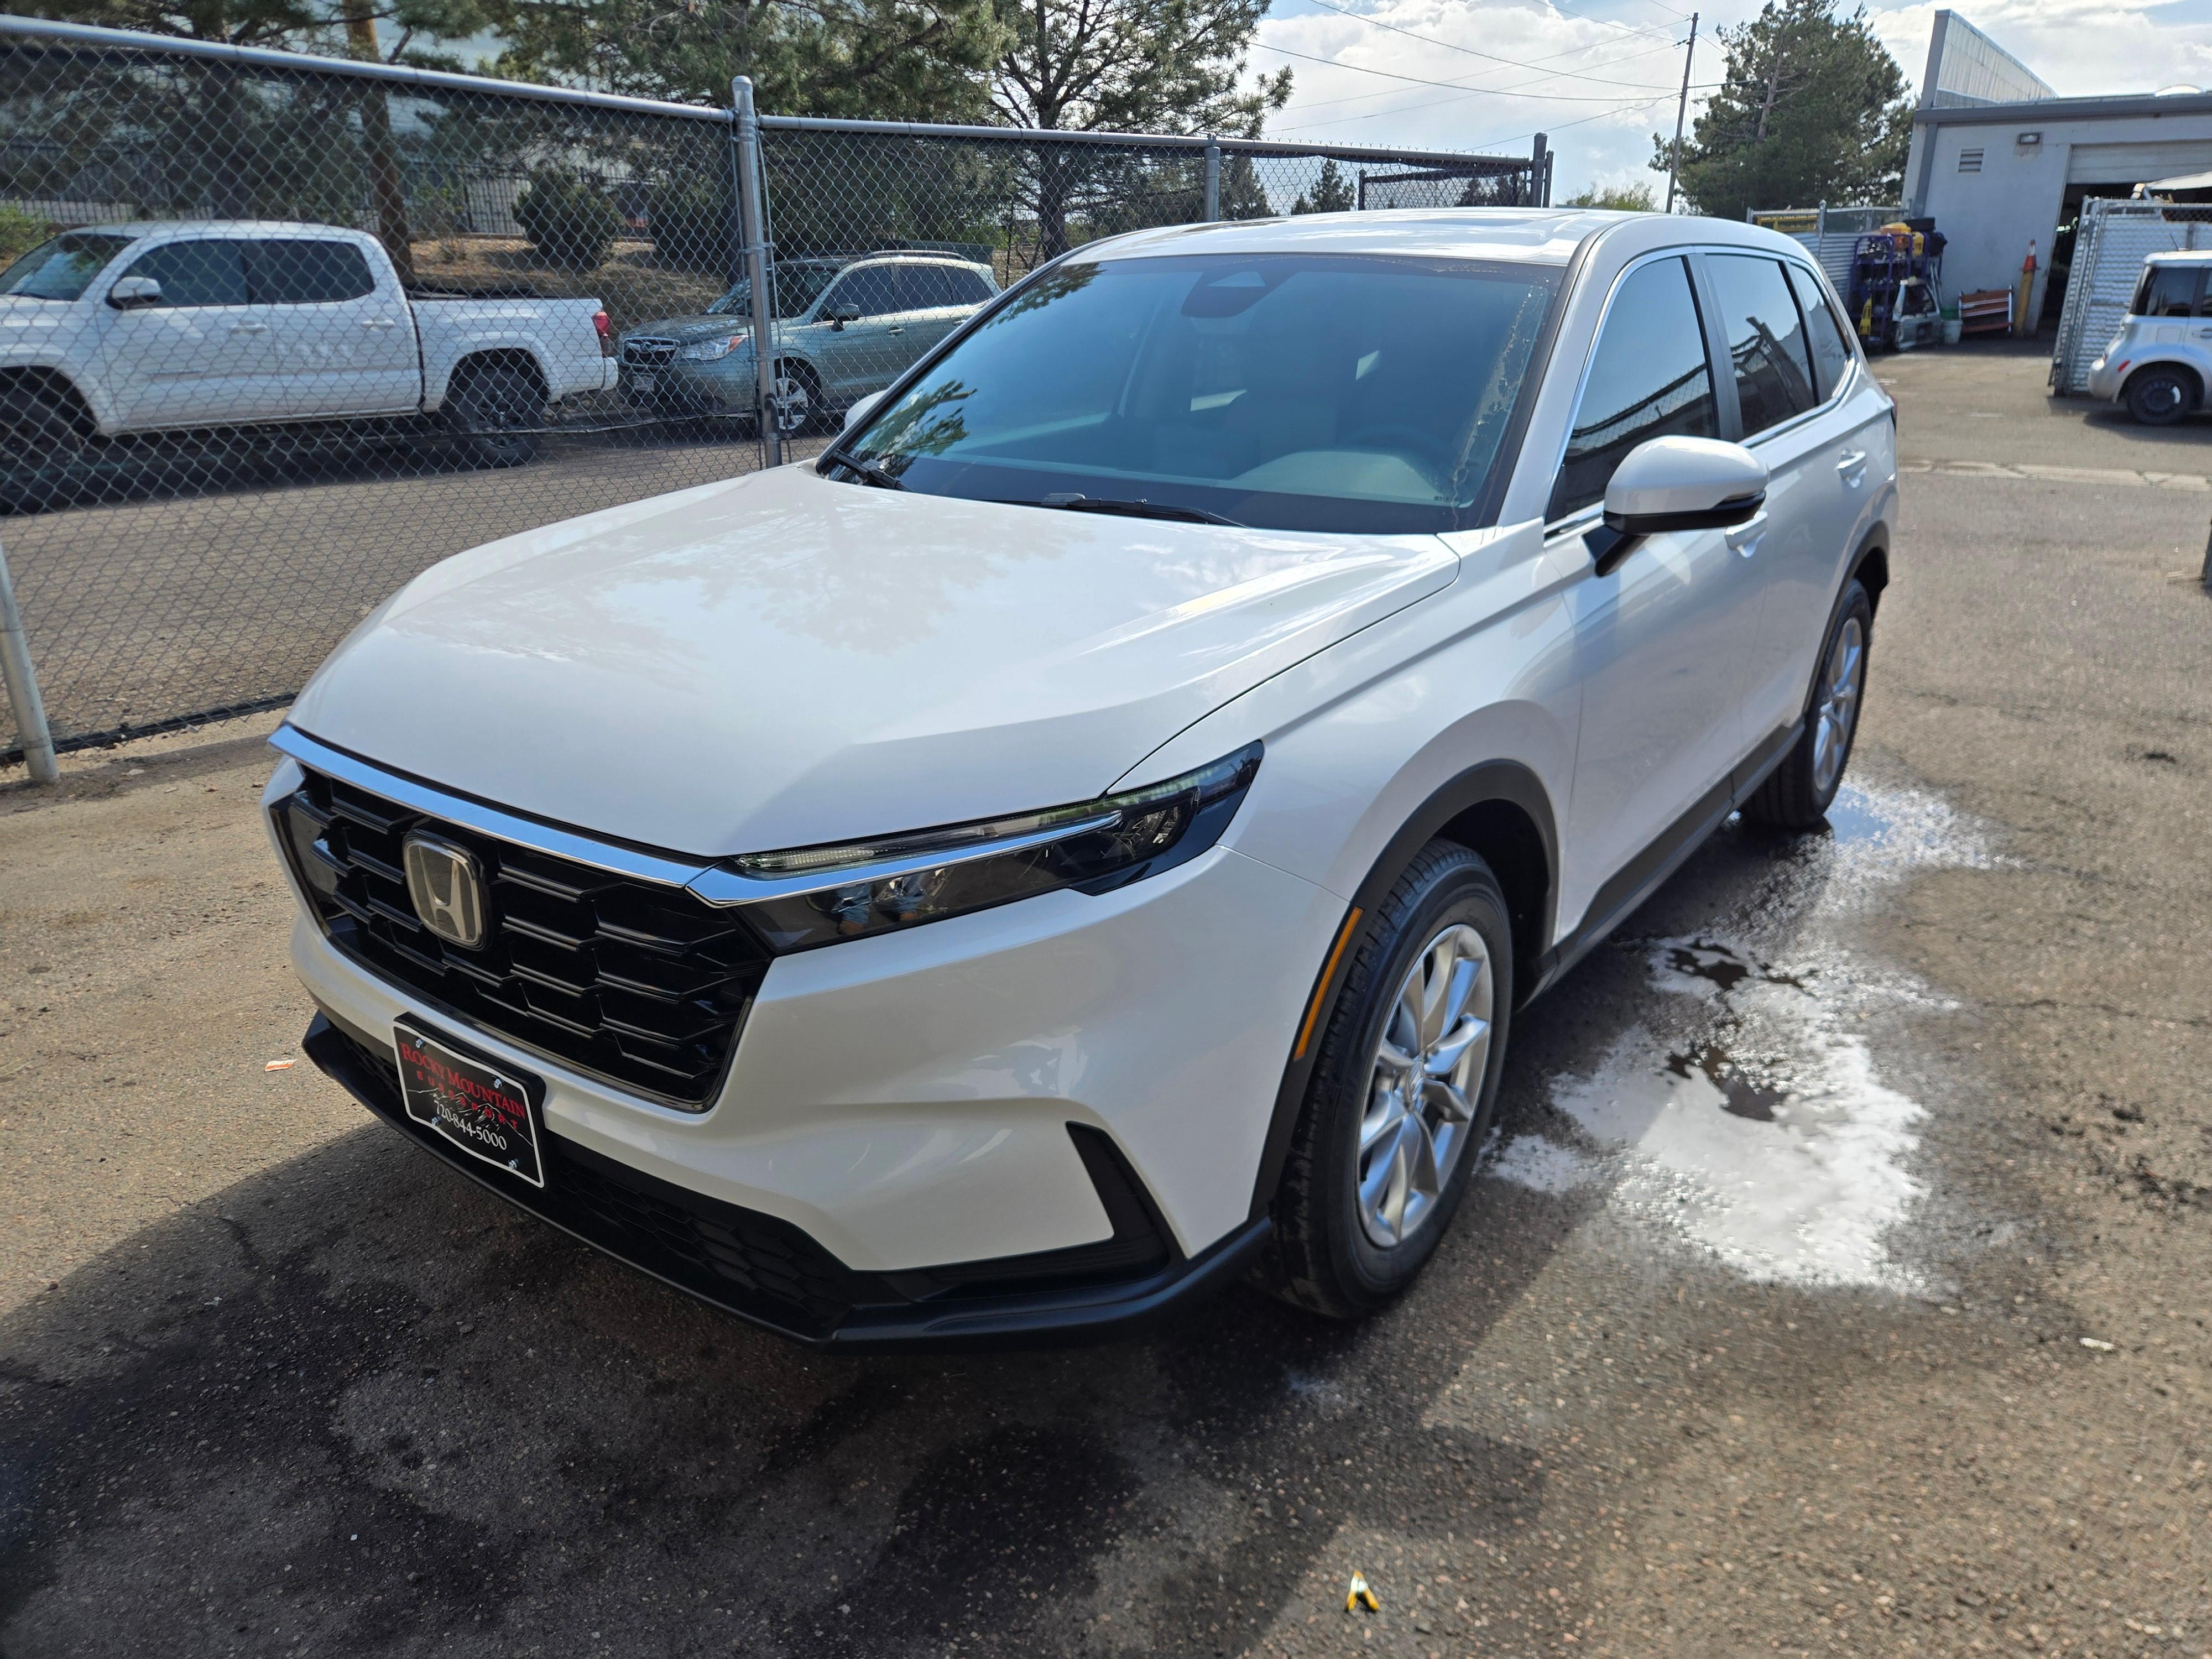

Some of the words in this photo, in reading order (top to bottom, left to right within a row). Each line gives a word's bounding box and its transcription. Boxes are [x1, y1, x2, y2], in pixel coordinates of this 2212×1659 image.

[401, 1043, 445, 1079] ROCKY
[447, 1068, 525, 1119] MOUNTAIN
[416, 1070, 518, 1129] EUROSPORT
[434, 1099, 507, 1150] 720-844-5000
